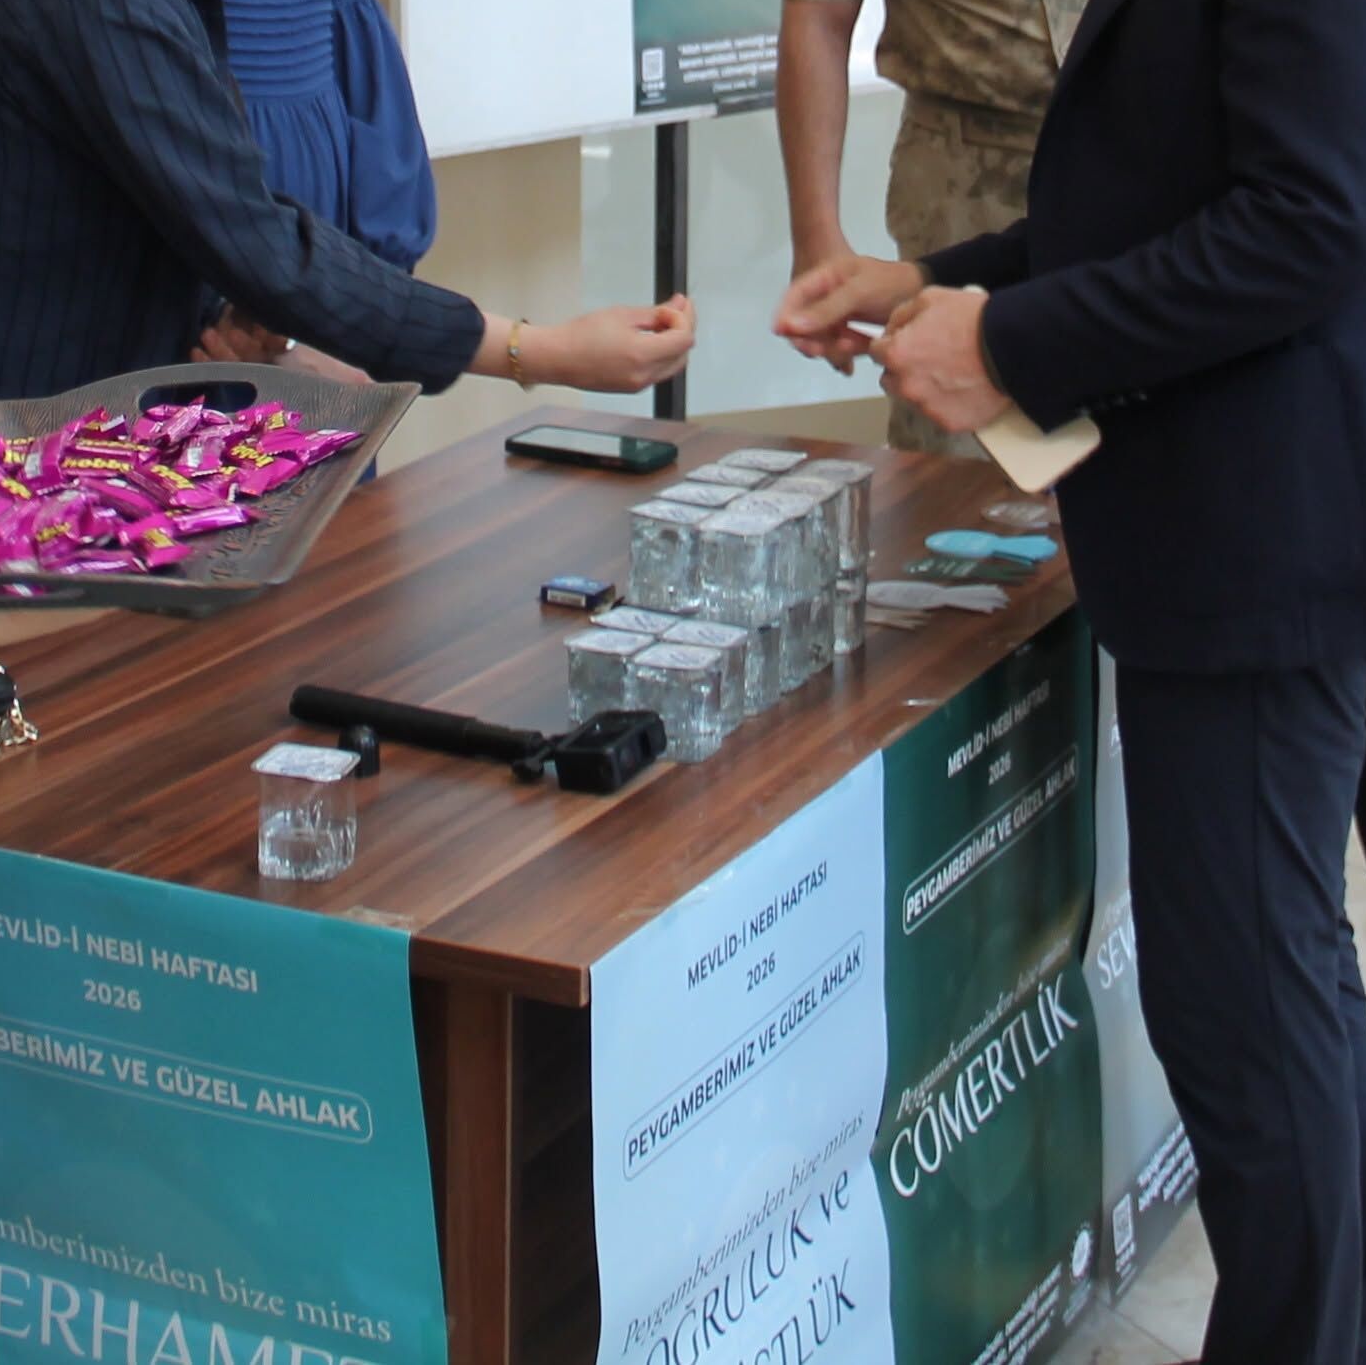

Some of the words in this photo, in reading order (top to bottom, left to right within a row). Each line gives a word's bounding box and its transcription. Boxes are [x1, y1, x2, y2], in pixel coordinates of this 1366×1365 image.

[948, 724, 989, 778] MEVLİD-İ
[991, 706, 1013, 738] NEBİ
[988, 751, 1011, 786] 2026
[906, 823, 996, 923] PEYGAMBERİMİZ
[997, 814, 1012, 843] VE
[1013, 791, 1044, 829] GÜZEL
[1045, 756, 1076, 802] AHLAK
[86, 932, 144, 967] NEBİ
[151, 947, 258, 993] HAFTASI
[688, 921, 747, 991] MEVLİD-İ
[749, 896, 778, 943] NEBİ
[781, 860, 827, 917] HAFTASI
[83, 978, 142, 1011] 2026
[747, 951, 776, 992] 2026
[111, 1054, 149, 1087] VE
[156, 1064, 248, 1110] GÜZEL
[255, 1089, 361, 1131] AHLAK
[628, 1042, 757, 1168] PEYGAMBERİMİZ
[759, 1022, 777, 1057] VE
[779, 985, 818, 1038] GÜZEL
[821, 945, 862, 1002] AHLAK
[889, 972, 1078, 1198] CÖMERTLİK
[622, 1187, 785, 1356] Peygamberimizden
[789, 1152, 822, 1196] bize
[823, 1110, 864, 1163] miras
[820, 1170, 851, 1224] ve
[215, 1268, 287, 1317] bize
[296, 1299, 392, 1343] miras
